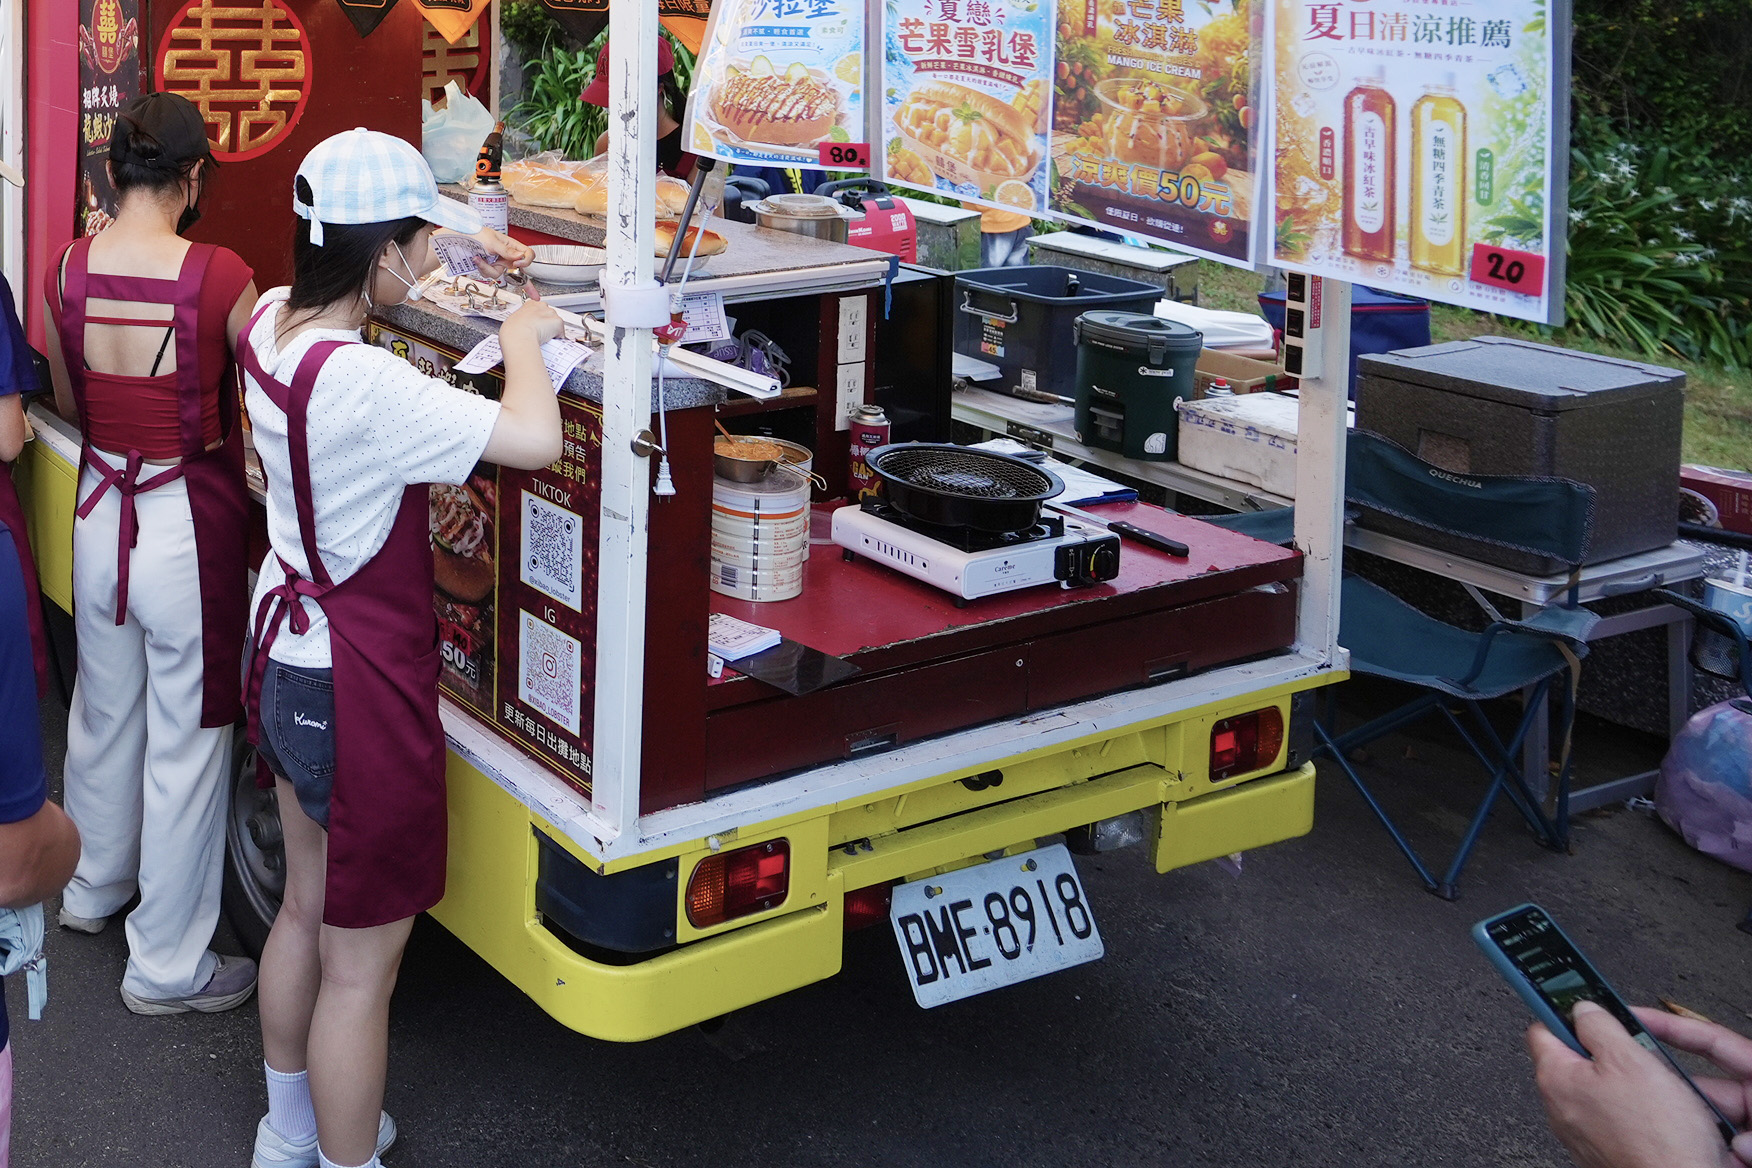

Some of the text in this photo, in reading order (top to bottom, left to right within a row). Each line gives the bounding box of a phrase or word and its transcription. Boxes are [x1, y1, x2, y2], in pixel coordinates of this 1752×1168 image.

[1113, 18, 1199, 55] 冰淇淋
[1303, 2, 1512, 49] 夏日清涼推薦
[898, 17, 1038, 69] 芒果雪乳堡
[1108, 55, 1202, 79] MANGO ICE CREAM
[83, 85, 119, 109] 招牌炙燒
[83, 111, 118, 144] 龍蝦沙
[1363, 125, 1376, 199] 古早味冰紅茶
[1433, 135, 1446, 210] 無糖四季青茶
[1072, 152, 1232, 216] 涼爽價50元
[1487, 252, 1525, 284] 20
[561, 419, 587, 443] 地點
[545, 459, 586, 485] 蹤我們
[1429, 468, 1483, 489] QUECHUA
[532, 478, 572, 508] TIKTOK
[529, 575, 571, 603] @xibao_lobster
[544, 606, 556, 624] IG
[440, 640, 476, 680] 50元
[294, 711, 328, 730] Kuromi
[528, 694, 570, 727] @XIBAO_LOBSTER
[504, 701, 592, 775] 更新每日出攤地點
[898, 872, 1092, 987] BME-8918
